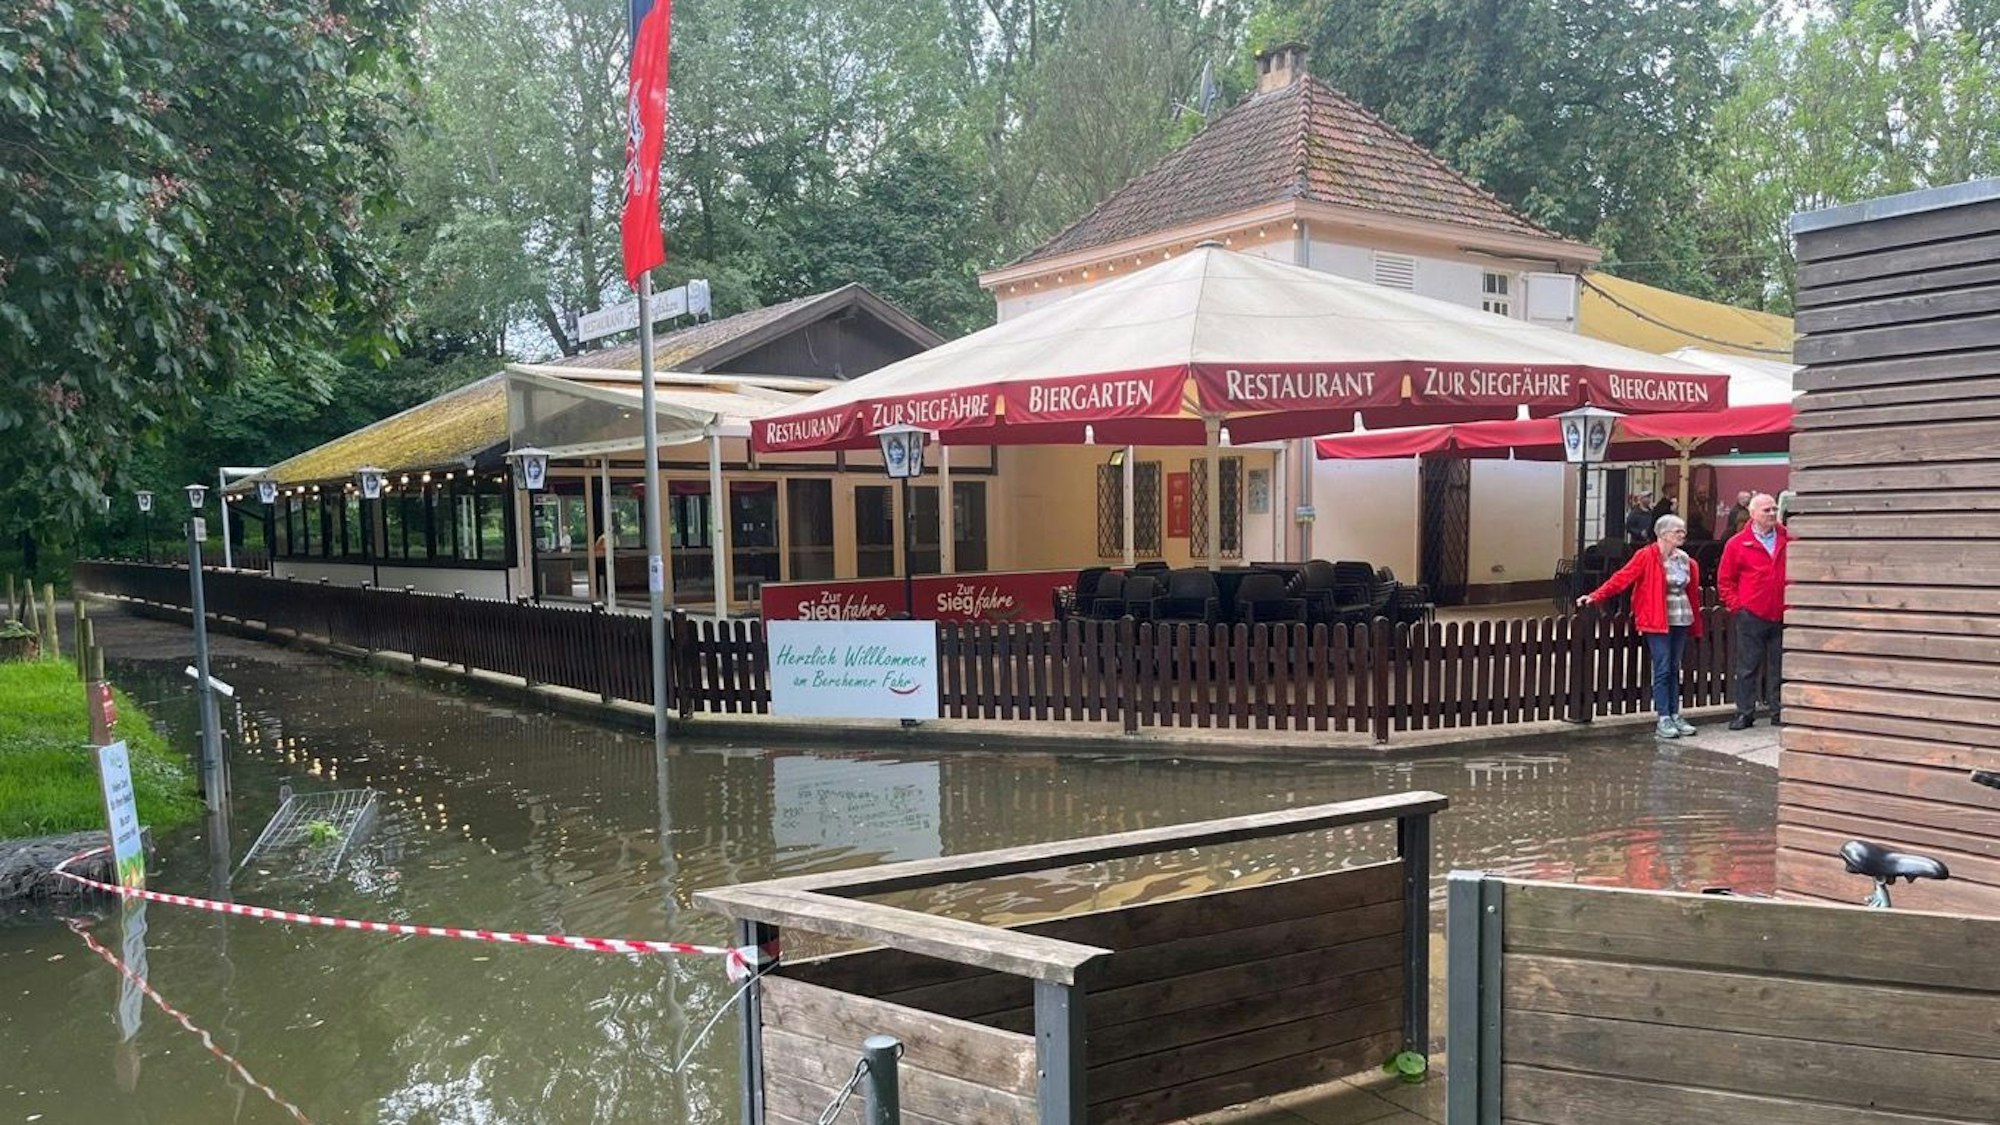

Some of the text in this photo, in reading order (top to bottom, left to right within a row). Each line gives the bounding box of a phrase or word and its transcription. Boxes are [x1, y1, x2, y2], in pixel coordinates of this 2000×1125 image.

[1028, 379, 1154, 413] BIERGARTEN
[1225, 369, 1375, 401] RESTAURANT
[1423, 367, 1571, 397] ZUR SIEGFÄHRE
[1608, 374, 1709, 403] BIERGARTEN
[872, 393, 989, 428] ZUR SIEGFÄHRE
[767, 413, 842, 445] RESTAURANT
[821, 591, 842, 604] Zur
[957, 583, 975, 596] Zur
[776, 644, 928, 668] Herzlich Willkommen
